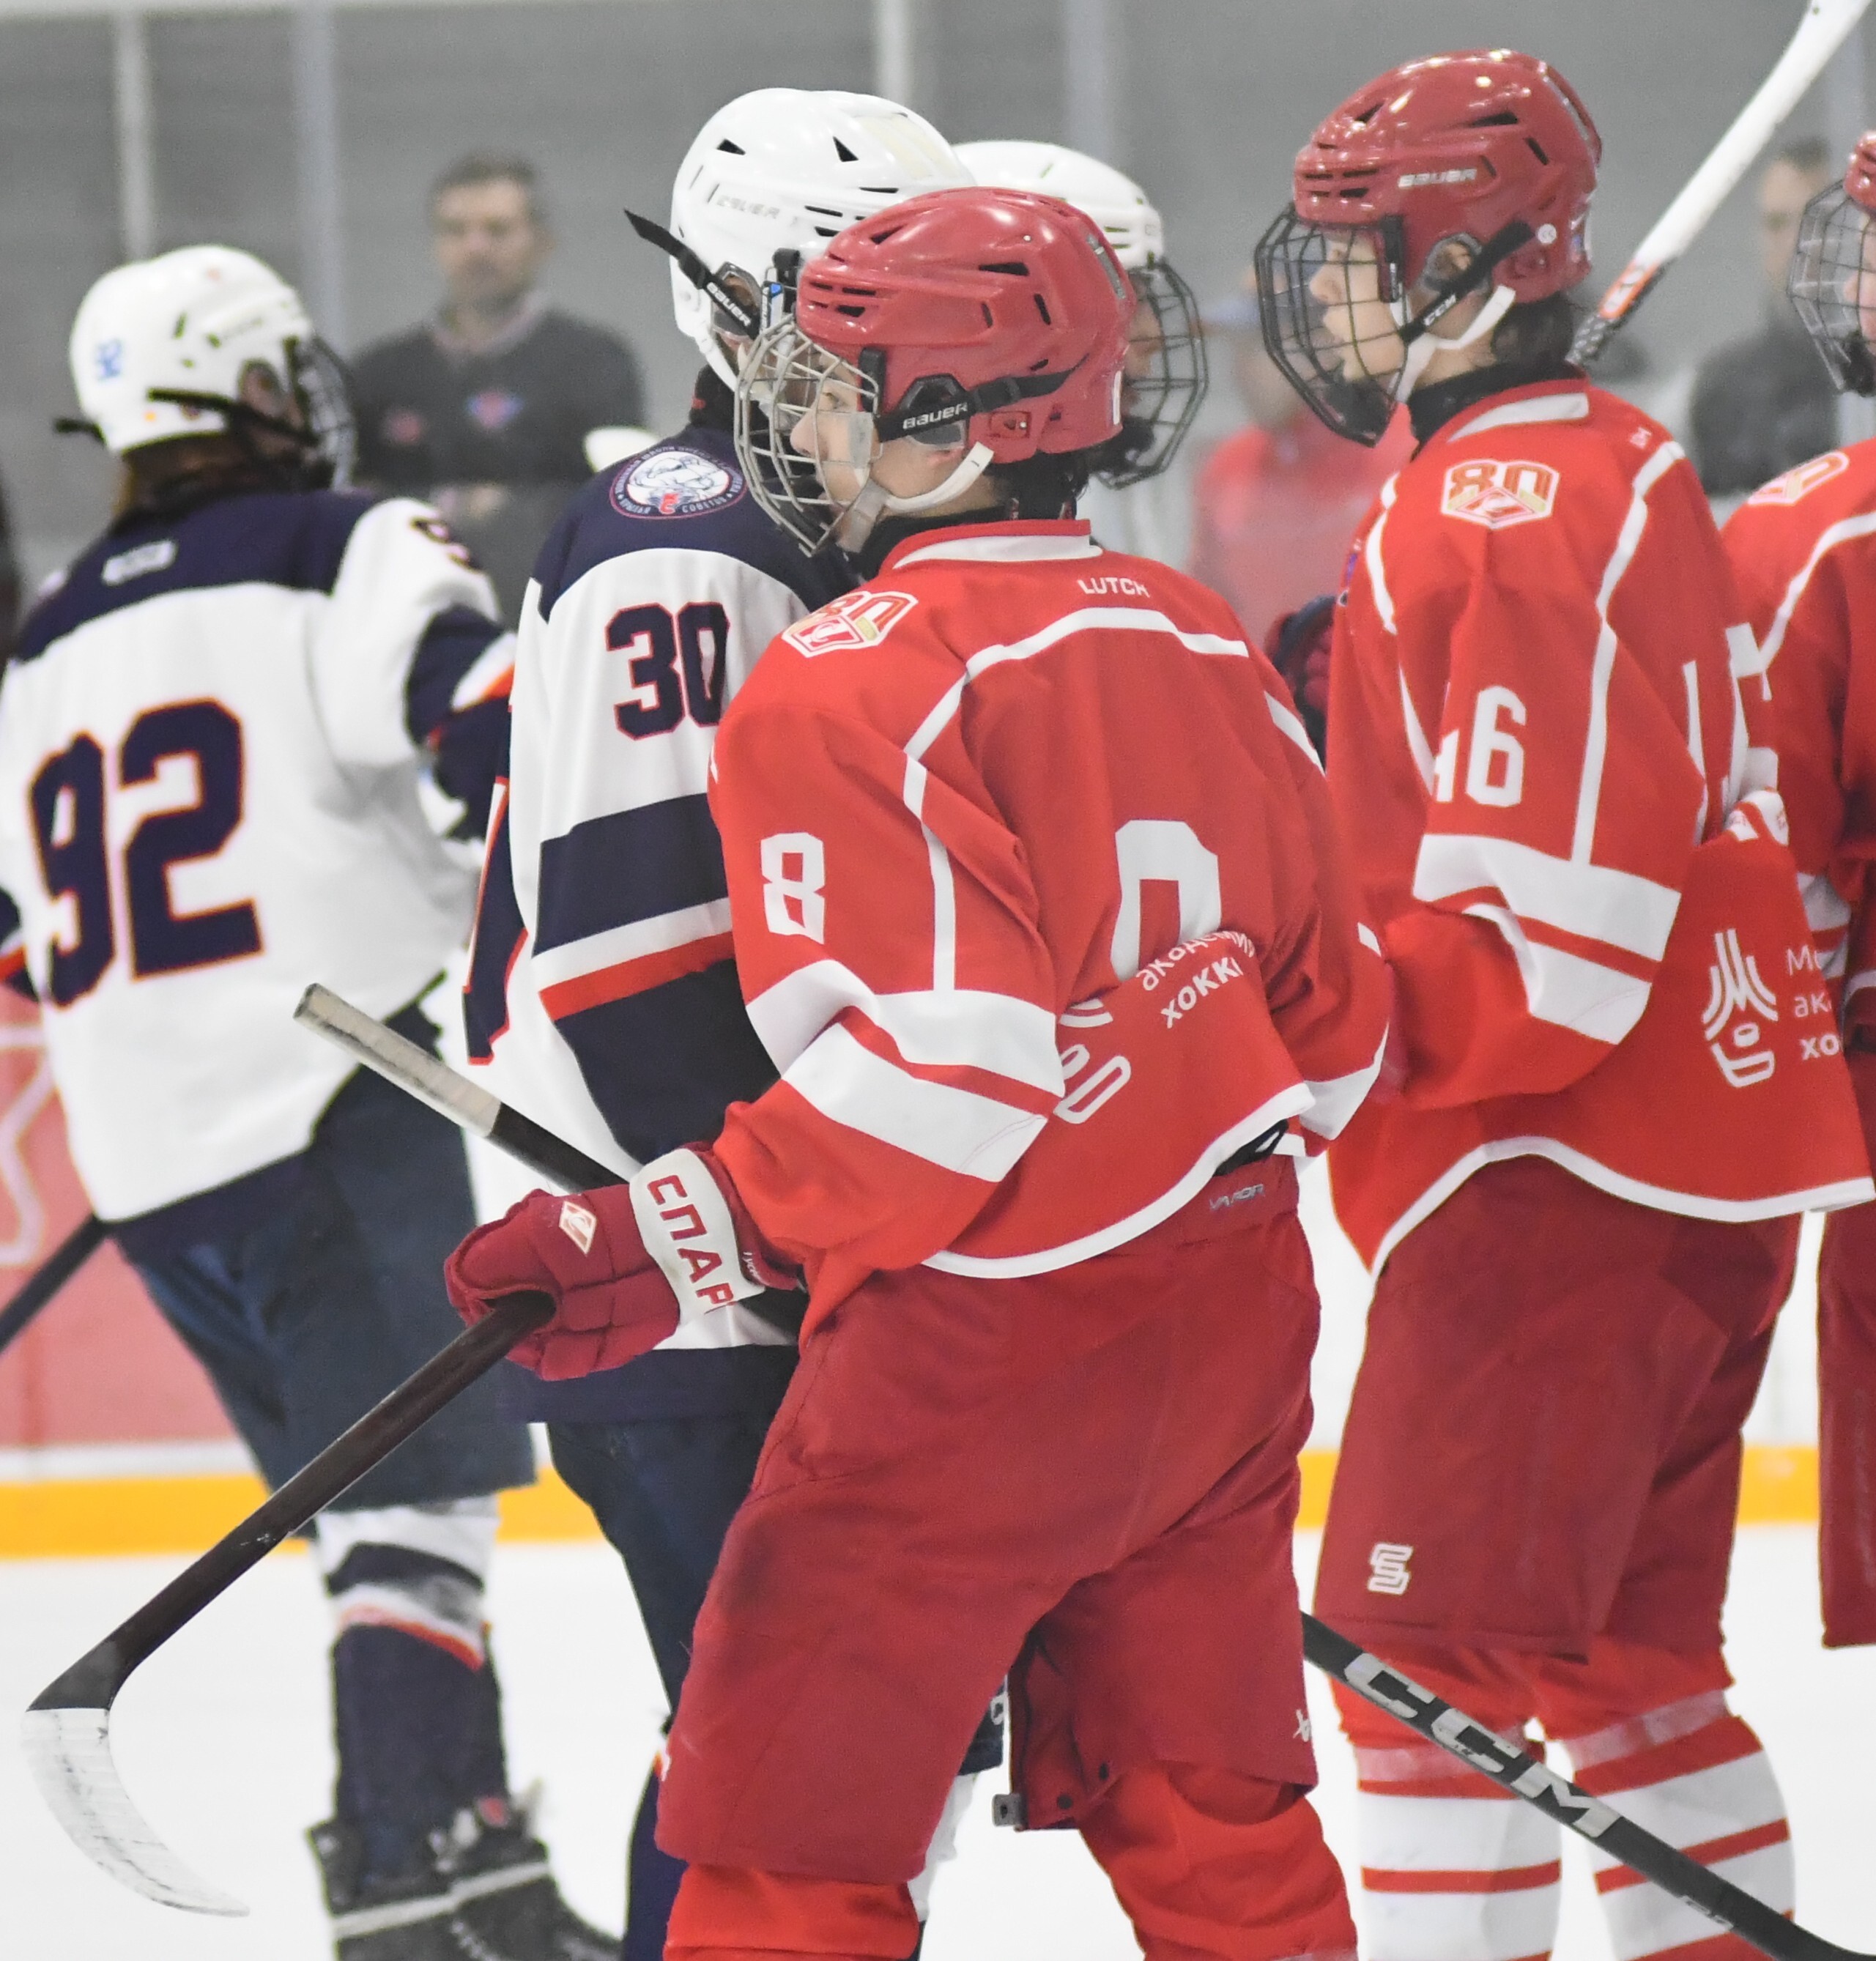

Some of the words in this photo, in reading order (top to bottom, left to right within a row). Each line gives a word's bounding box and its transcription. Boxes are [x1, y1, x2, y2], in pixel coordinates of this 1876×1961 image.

[706, 281, 752, 327] BAUER
[902, 401, 968, 429] BAUER
[1077, 577, 1150, 598] LUTCH
[605, 601, 730, 742] 30
[26, 694, 265, 1014] 92
[760, 831, 826, 944] 8
[647, 1174, 735, 1316] СПАР
[1345, 1653, 1623, 1838] CCM
